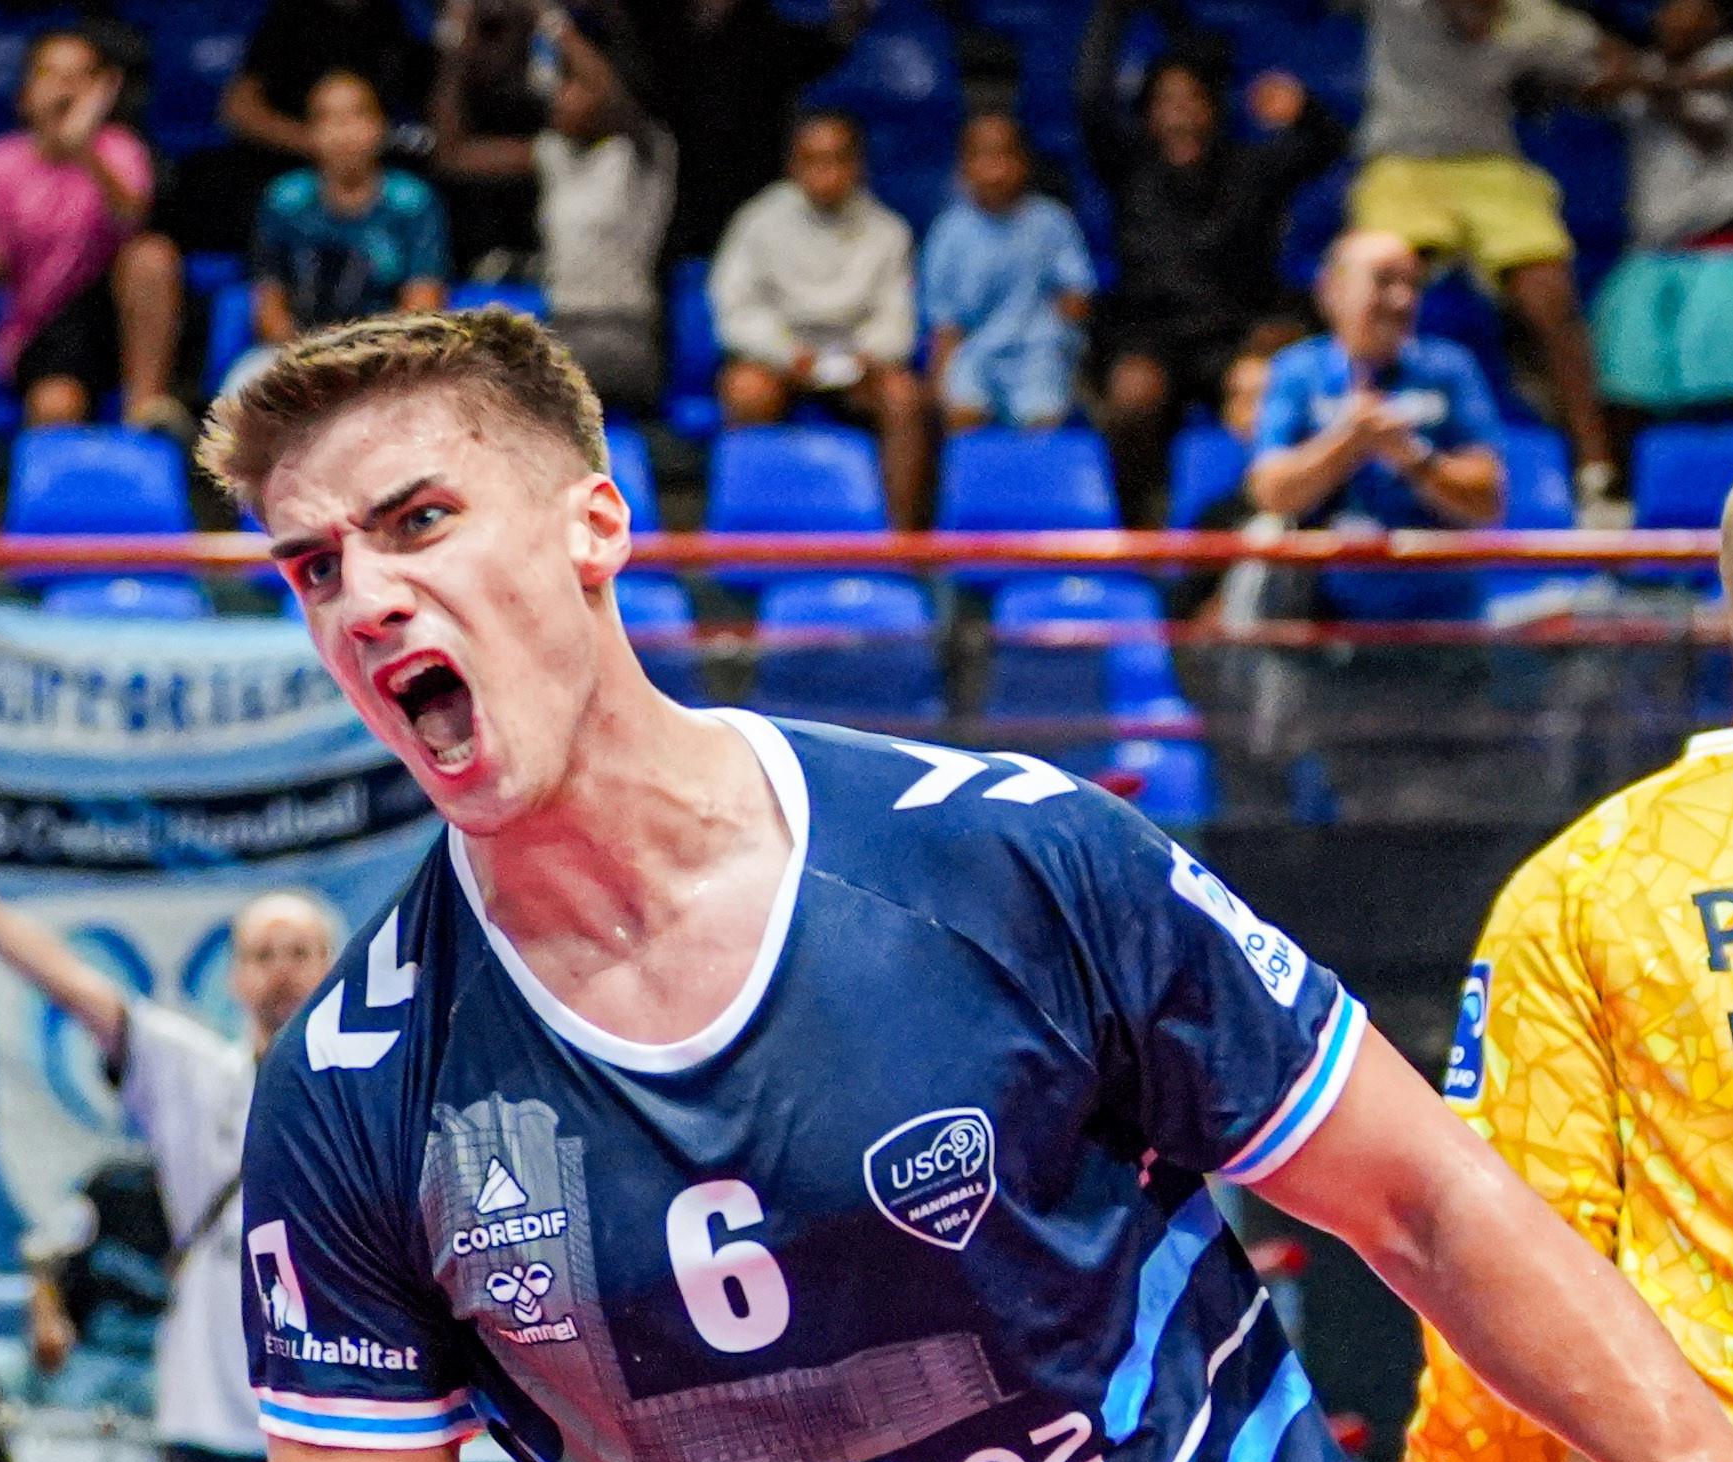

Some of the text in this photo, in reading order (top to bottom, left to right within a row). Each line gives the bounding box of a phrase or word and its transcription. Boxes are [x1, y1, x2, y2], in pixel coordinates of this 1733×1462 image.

[452, 1210, 568, 1256] COREDIF
[666, 1178, 791, 1354] 6
[498, 1315, 579, 1345] ummel
